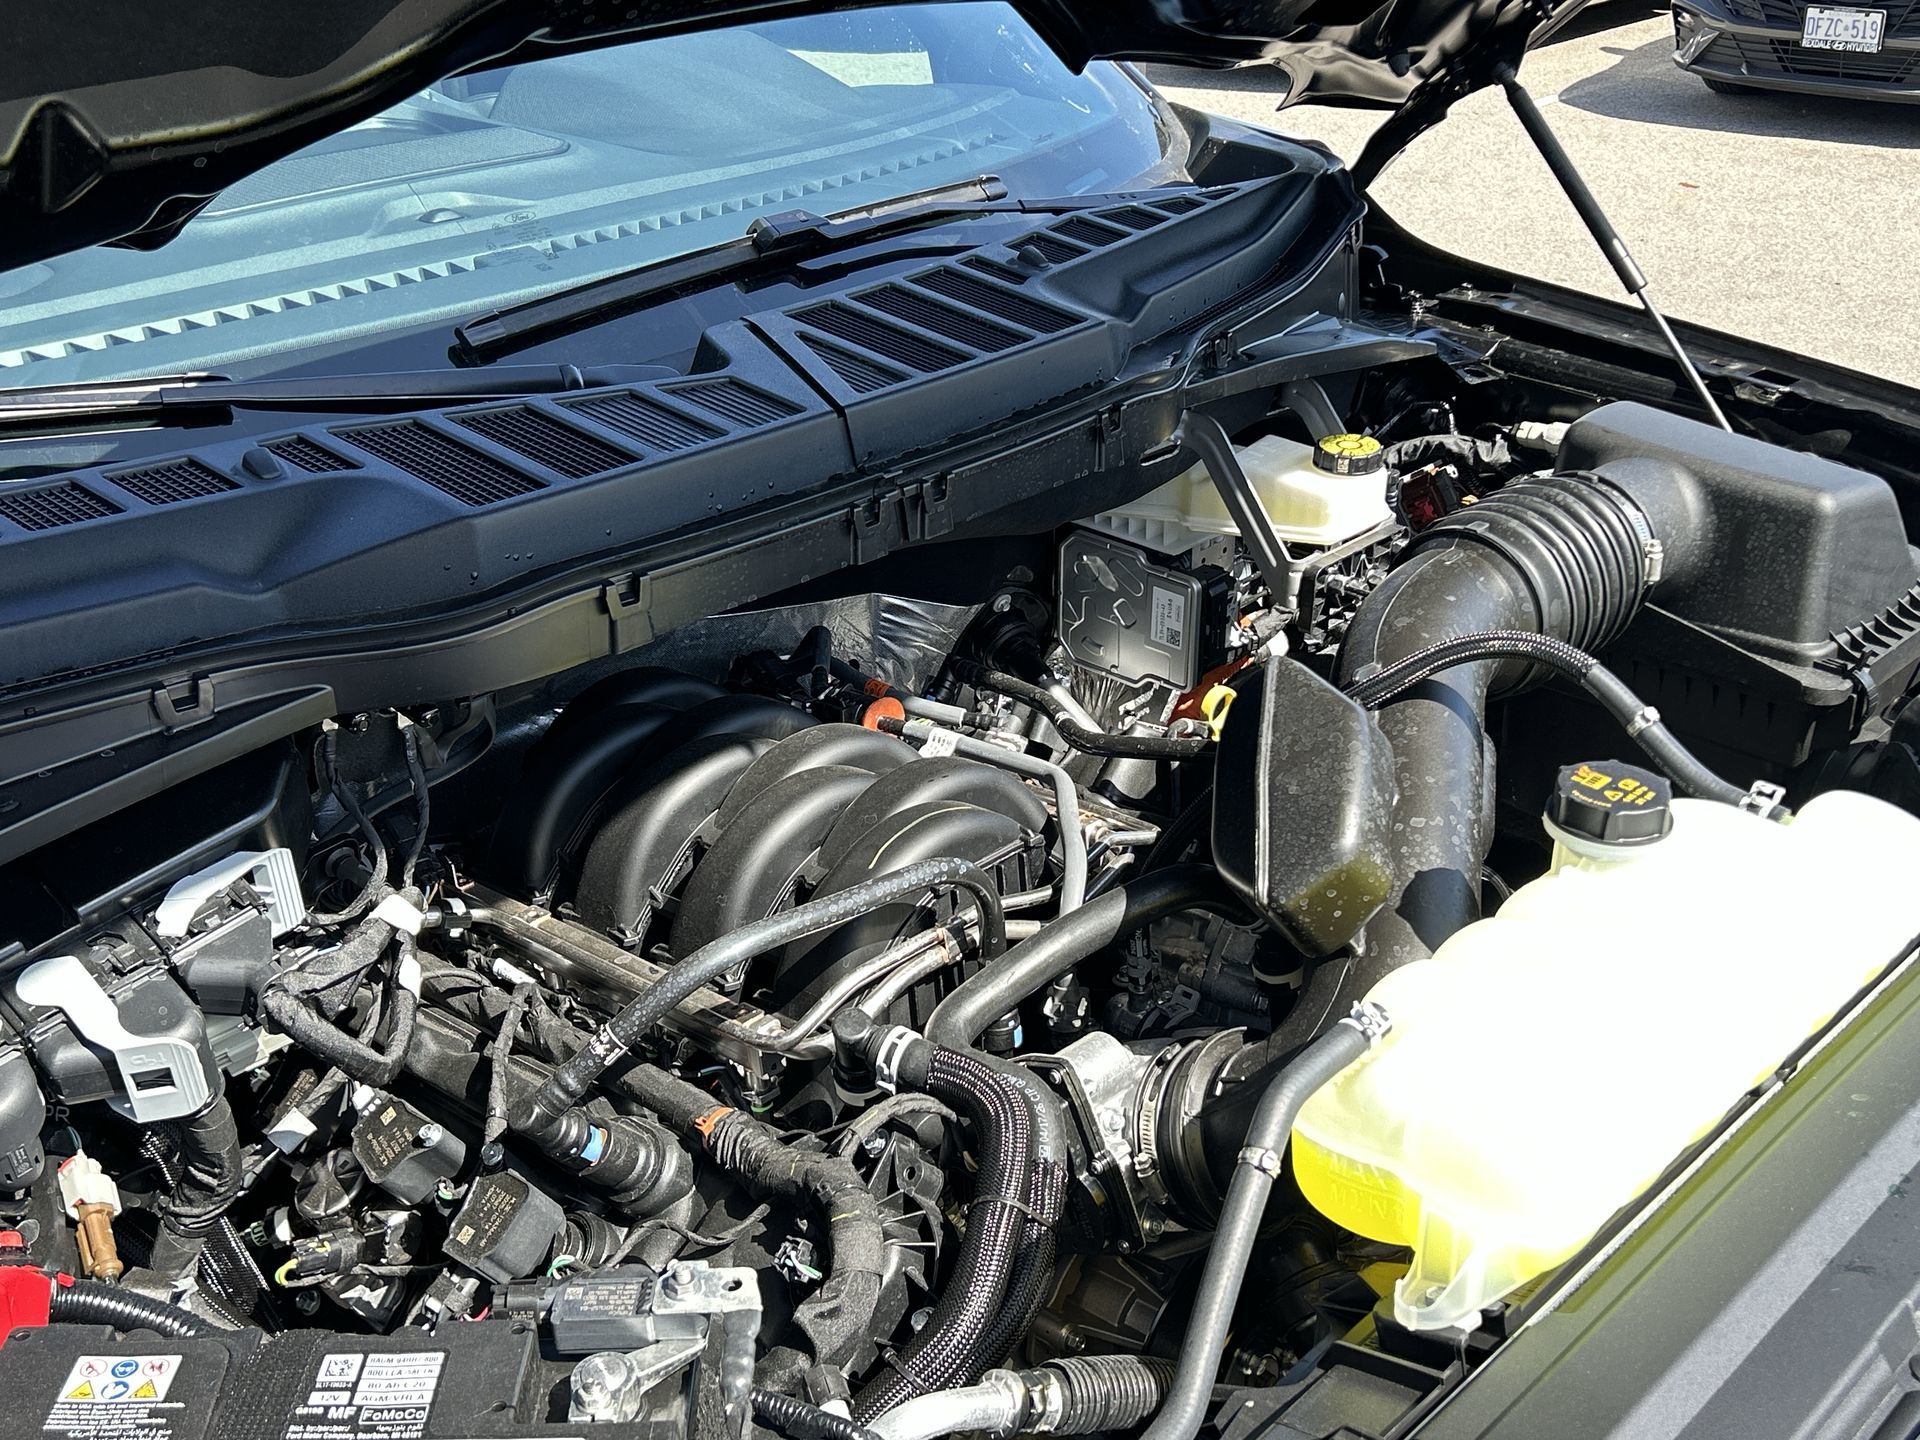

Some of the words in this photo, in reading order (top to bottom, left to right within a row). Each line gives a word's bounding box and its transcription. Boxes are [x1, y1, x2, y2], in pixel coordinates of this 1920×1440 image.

[1805, 16, 1843, 38] DFZC
[1850, 19, 1879, 40] 519
[328, 1406, 357, 1419] MF
[363, 1409, 425, 1420] FoMoCo
